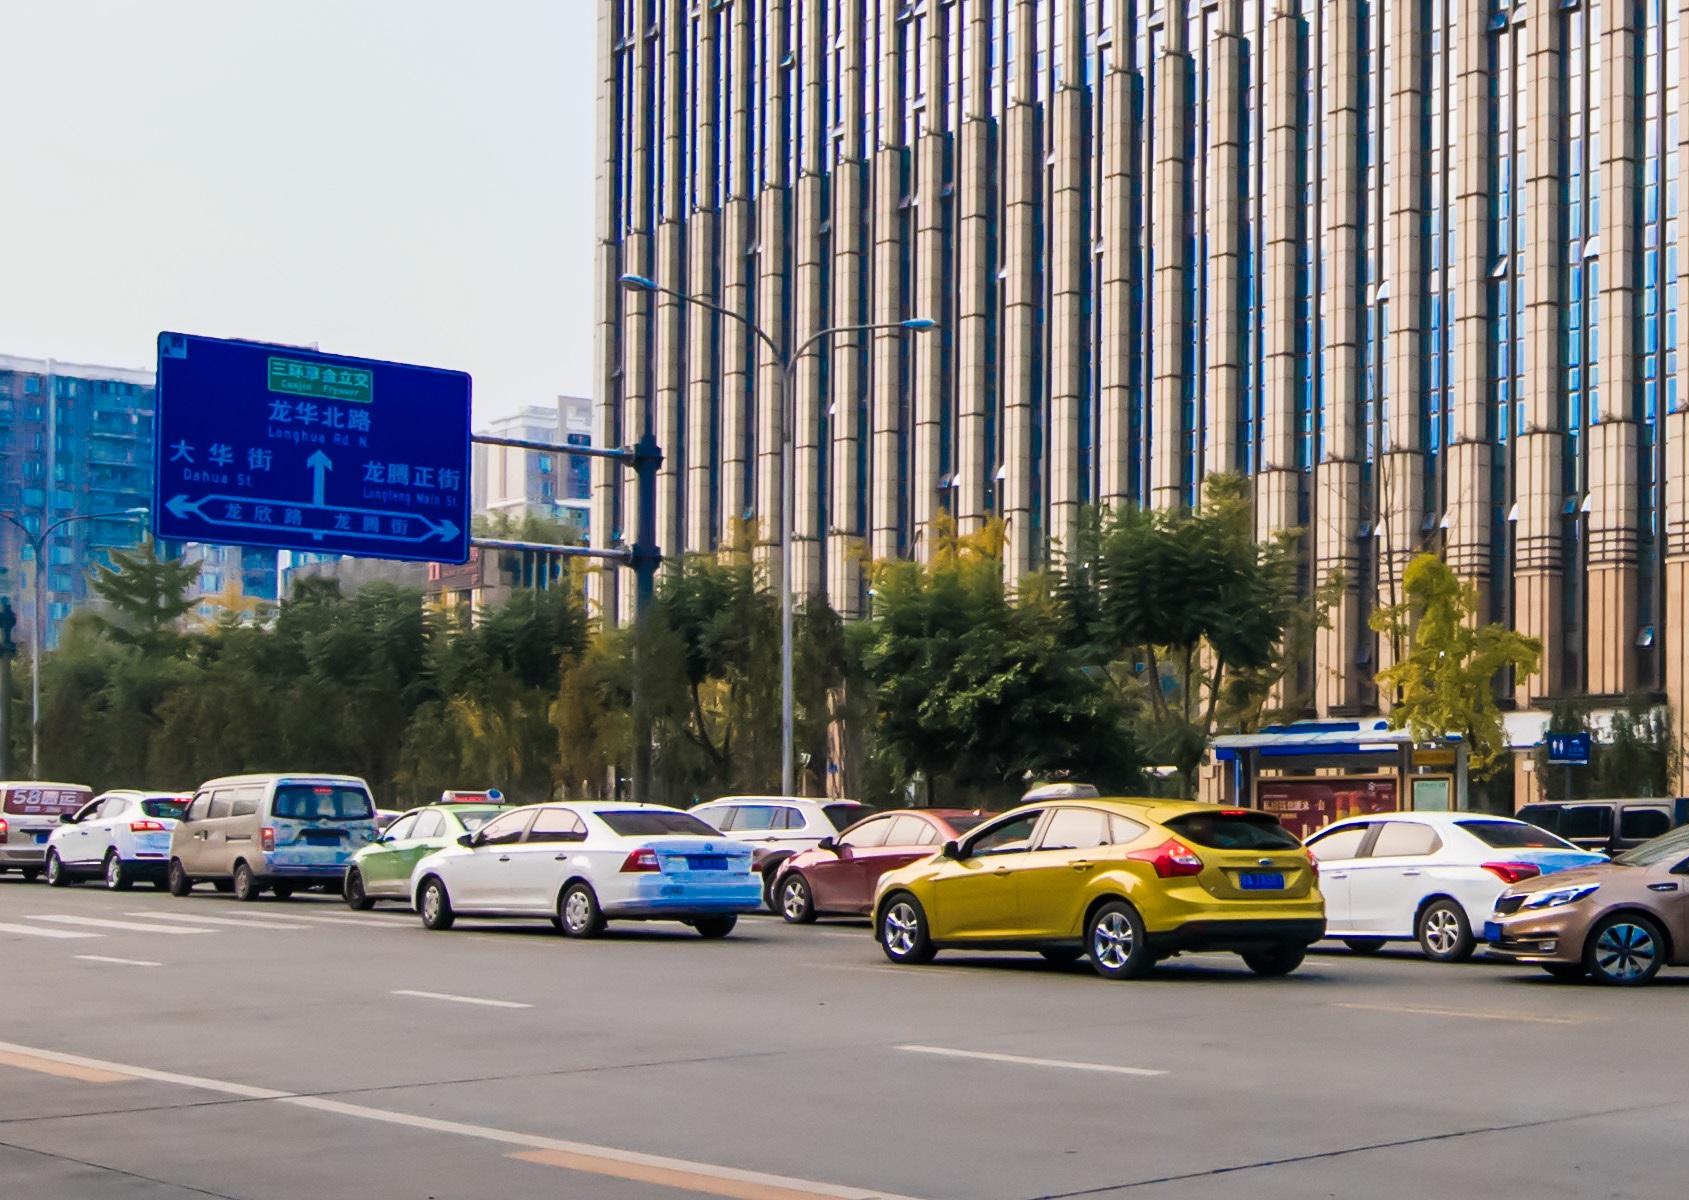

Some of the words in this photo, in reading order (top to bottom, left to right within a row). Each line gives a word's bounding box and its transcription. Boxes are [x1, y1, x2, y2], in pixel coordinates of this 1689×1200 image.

[267, 399, 371, 432] 龙华北路
[169, 439, 273, 472] 大华街
[183, 467, 228, 484] Dahua
[362, 460, 460, 491] 龙腾正街
[224, 502, 302, 528] 龙欣路
